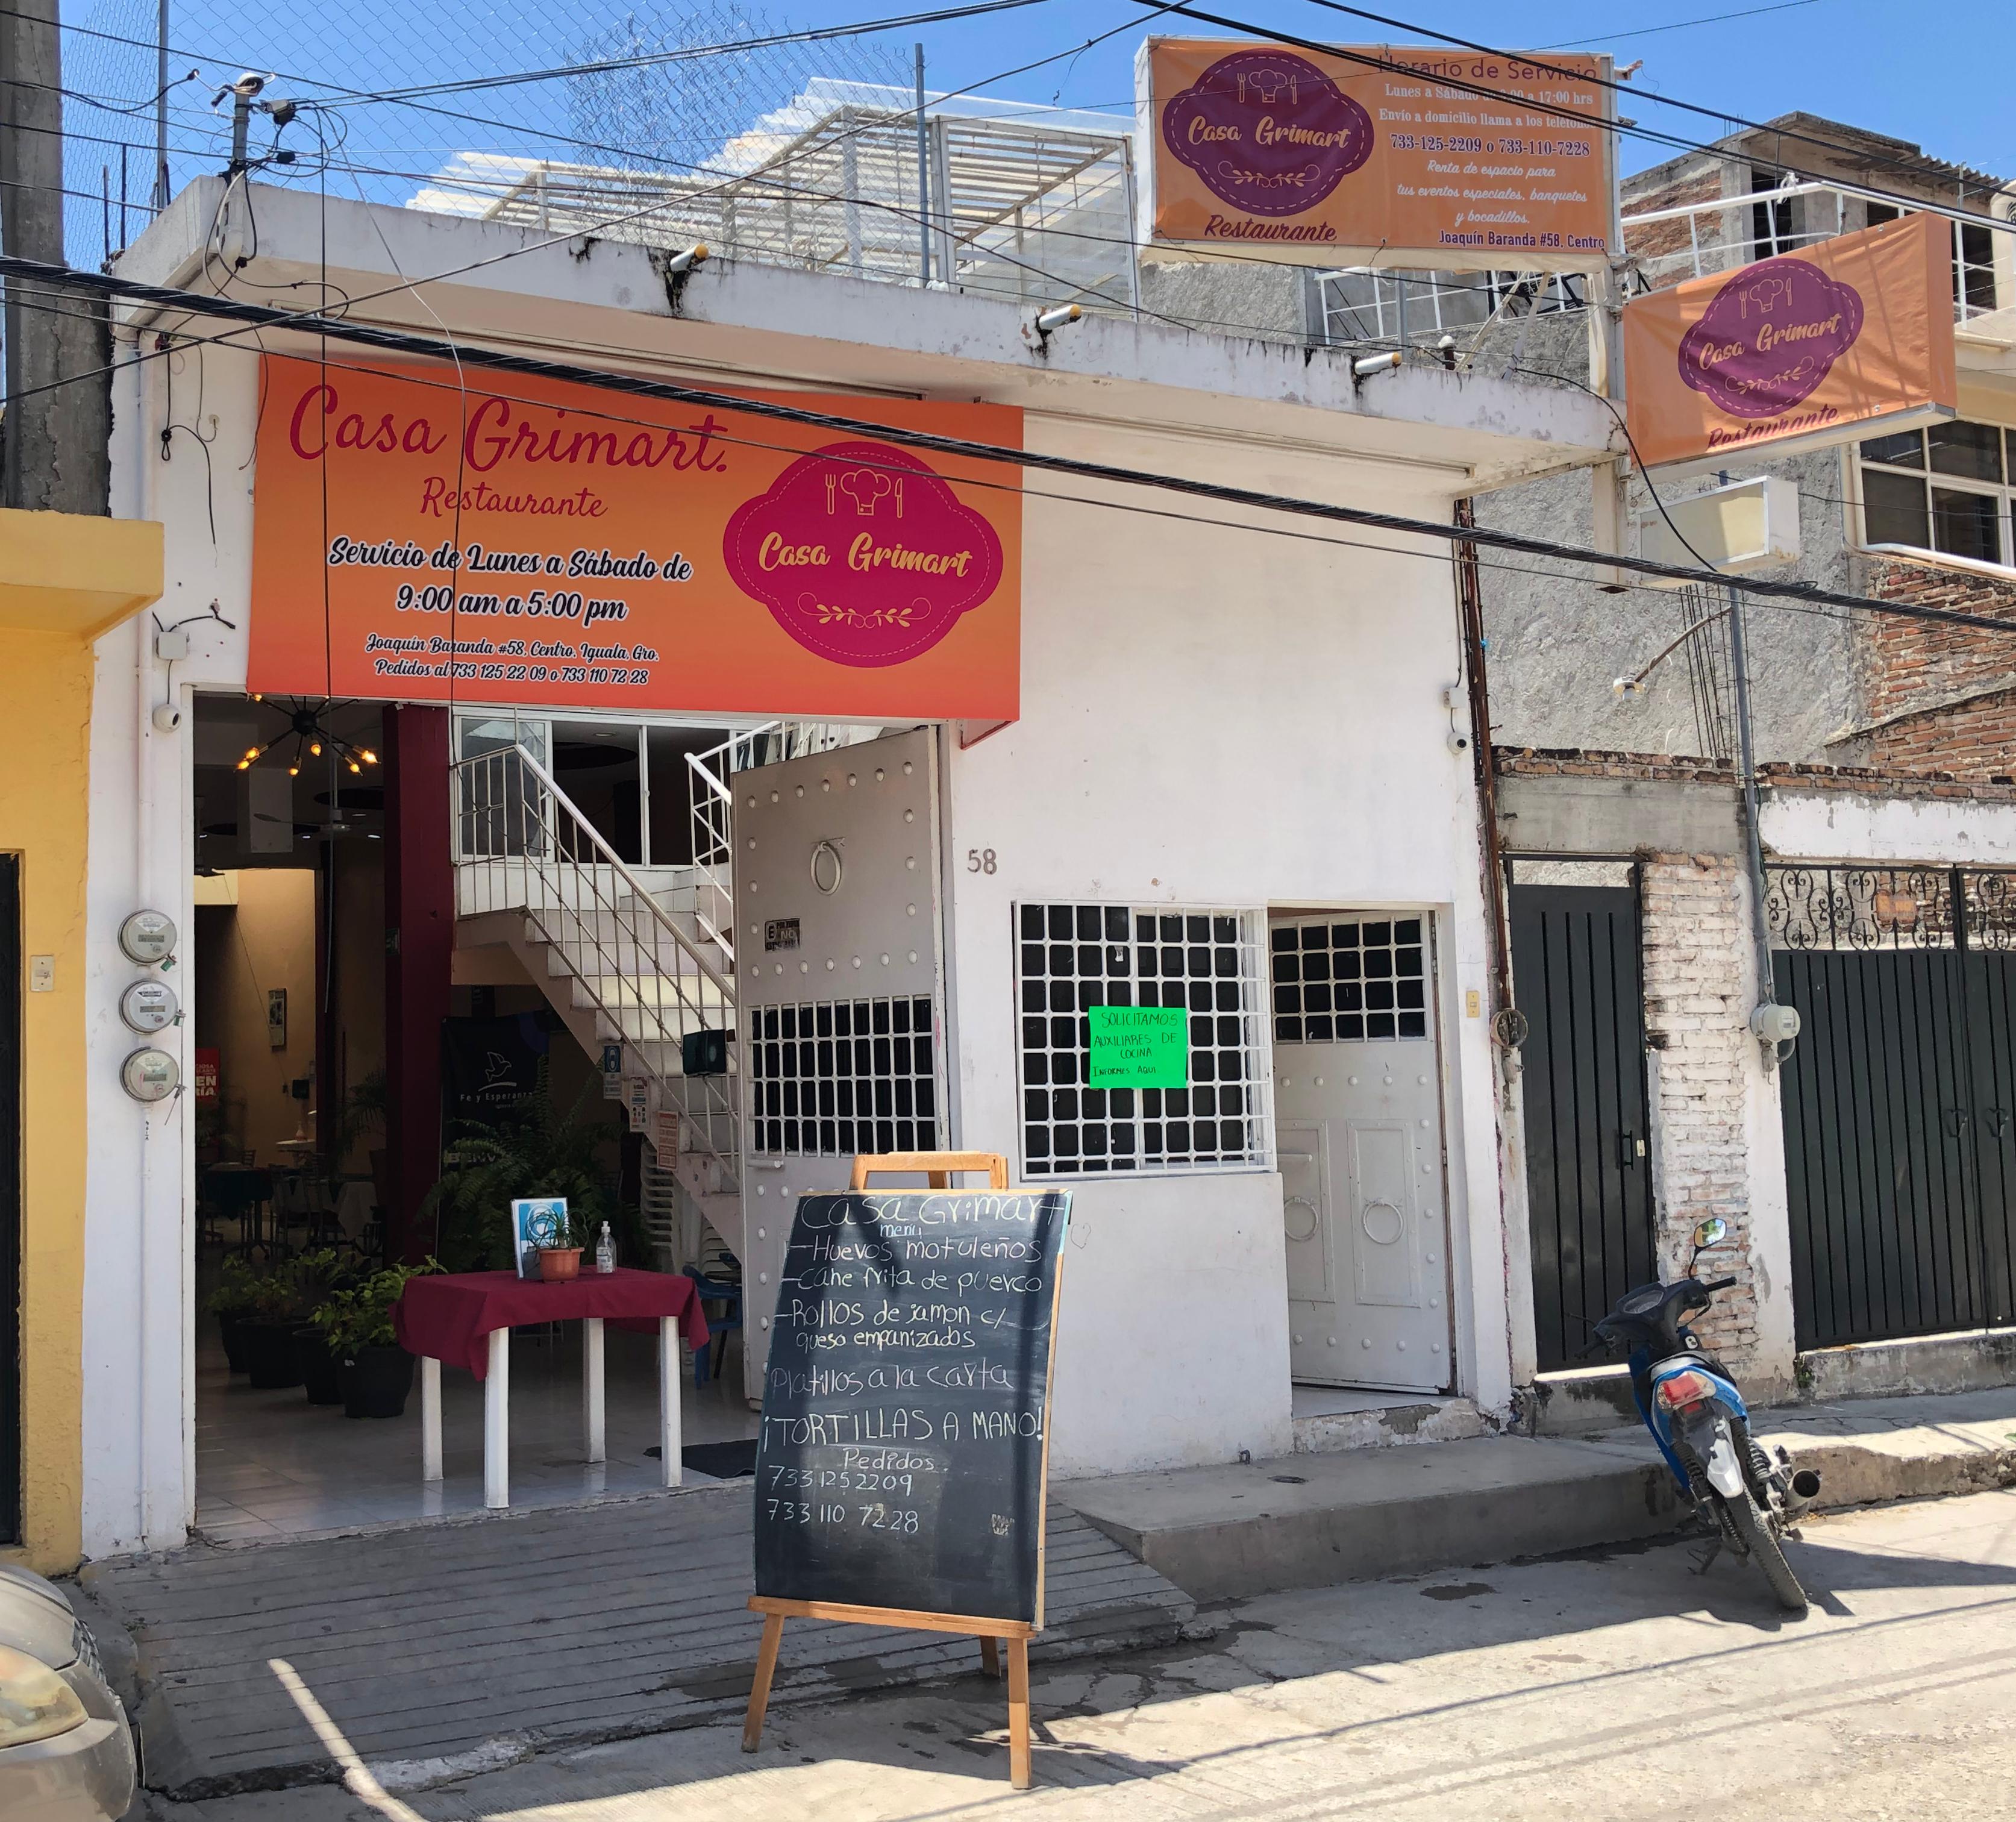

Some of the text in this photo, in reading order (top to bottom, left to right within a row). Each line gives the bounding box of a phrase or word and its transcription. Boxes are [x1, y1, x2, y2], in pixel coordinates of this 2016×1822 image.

[1471, 58, 1498, 78] de
[1508, 60, 1597, 82] Servicio
[1385, 83, 1421, 98] Lunes
[1424, 87, 1432, 97] a
[1539, 91, 1571, 104] 17:00
[1574, 91, 1593, 104] hrs
[1379, 108, 1412, 122] Envío
[1414, 112, 1421, 122] a
[1425, 110, 1477, 125] domicilio
[1480, 113, 1512, 126] llama
[1515, 117, 1523, 127] a
[1526, 114, 1542, 127] los
[1188, 115, 1351, 148] Casa Grimart
[1391, 134, 1591, 157] 733-125-2209 o 733-110-7228
[1427, 160, 1557, 180] Renta de espacio para
[1397, 183, 1415, 196] tus
[1417, 185, 1459, 198] eventos
[1530, 188, 1588, 204] banquetes
[1204, 214, 1338, 242] Restaurante
[1454, 210, 1530, 227] y bocadillos.
[1439, 230, 1484, 245] Joaquín
[1488, 232, 1536, 247] Baranda
[1567, 234, 1604, 249] Centro
[1698, 313, 1842, 370] Casa Grimart
[290, 384, 728, 472] Casa Grimart.
[1706, 404, 1839, 451] Restaurante
[420, 477, 609, 518] Restaurante
[328, 536, 693, 583] Servicio de Lunes a Sábado de
[758, 531, 974, 578] Casa Grimart
[395, 583, 628, 628] 9:00 am a 5:00 pm
[365, 633, 426, 655] Joaquín
[429, 636, 494, 655] Baranda
[632, 645, 660, 662] Gro.
[375, 659, 650, 685] Pedidos al 733 125 22 09 o 733 110 72 28
[967, 848, 997, 875] 58
[1101, 1012, 1179, 1028] SOLICITAMOS
[1094, 1032, 1179, 1048] AUXILIARES DE
[1120, 1047, 1153, 1060] COCINA
[1137, 1065, 1157, 1074] AQUI
[460, 1094, 472, 1102] Fe
[475, 1094, 482, 1103] y
[802, 1195, 909, 1229] Casa
[906, 1236, 1042, 1263] motuleños
[863, 1265, 916, 1289] frita
[921, 1269, 950, 1289] de
[957, 1271, 1042, 1297] puerco
[873, 1292, 900, 1326] de
[981, 1307, 1007, 1329] c/
[796, 1326, 976, 1354] queso empanizados
[771, 1363, 864, 1400] Platillos
[868, 1368, 887, 1388] a
[895, 1365, 921, 1390] la
[763, 1406, 1044, 1453] ¡TORTILLAS A MANO!
[843, 1447, 934, 1470] Pedidos
[767, 1498, 919, 1534] 733 110 7228
